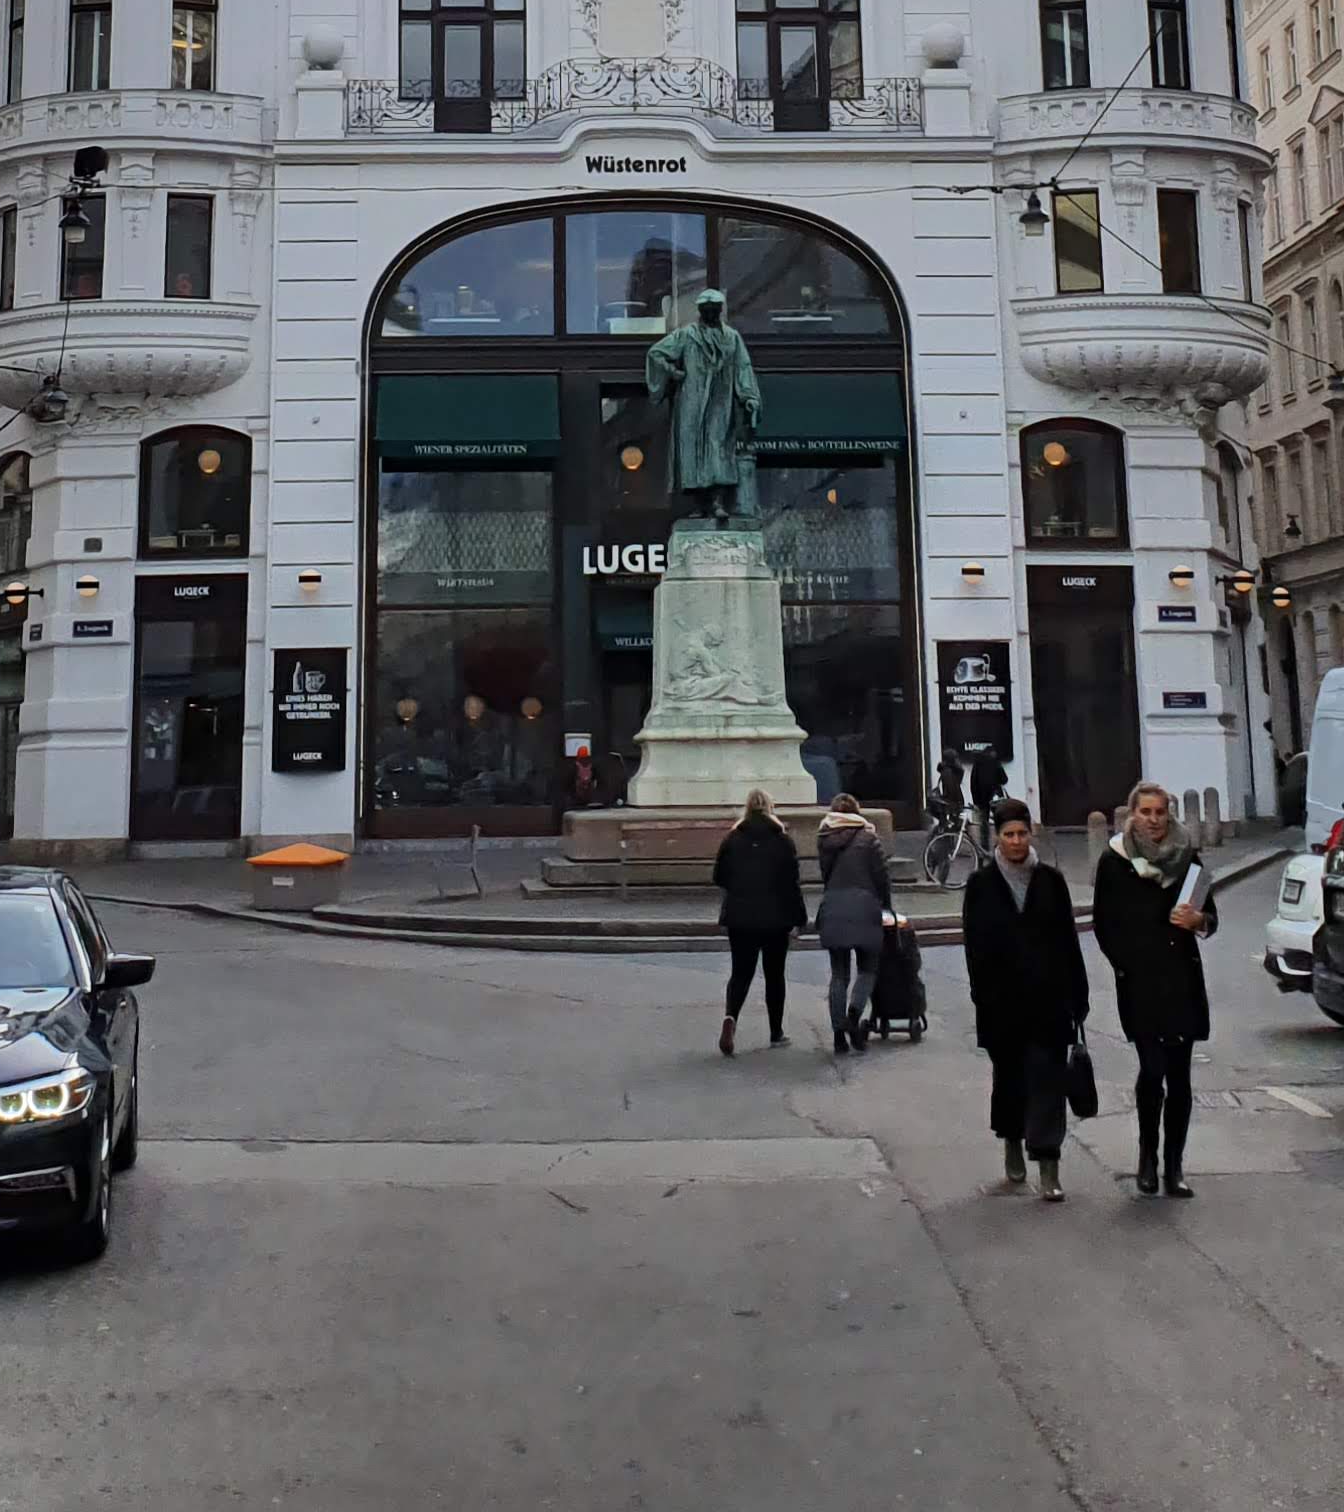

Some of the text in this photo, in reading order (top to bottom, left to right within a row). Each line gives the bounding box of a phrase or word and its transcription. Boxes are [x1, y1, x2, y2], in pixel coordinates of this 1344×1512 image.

[585, 155, 687, 174] Wüstenrot
[414, 444, 453, 455] WIENER
[582, 544, 669, 575] LUGE
[1062, 576, 1097, 587] LUGECK
[174, 586, 210, 597] LUGECK
[292, 752, 323, 761] LUGECK
